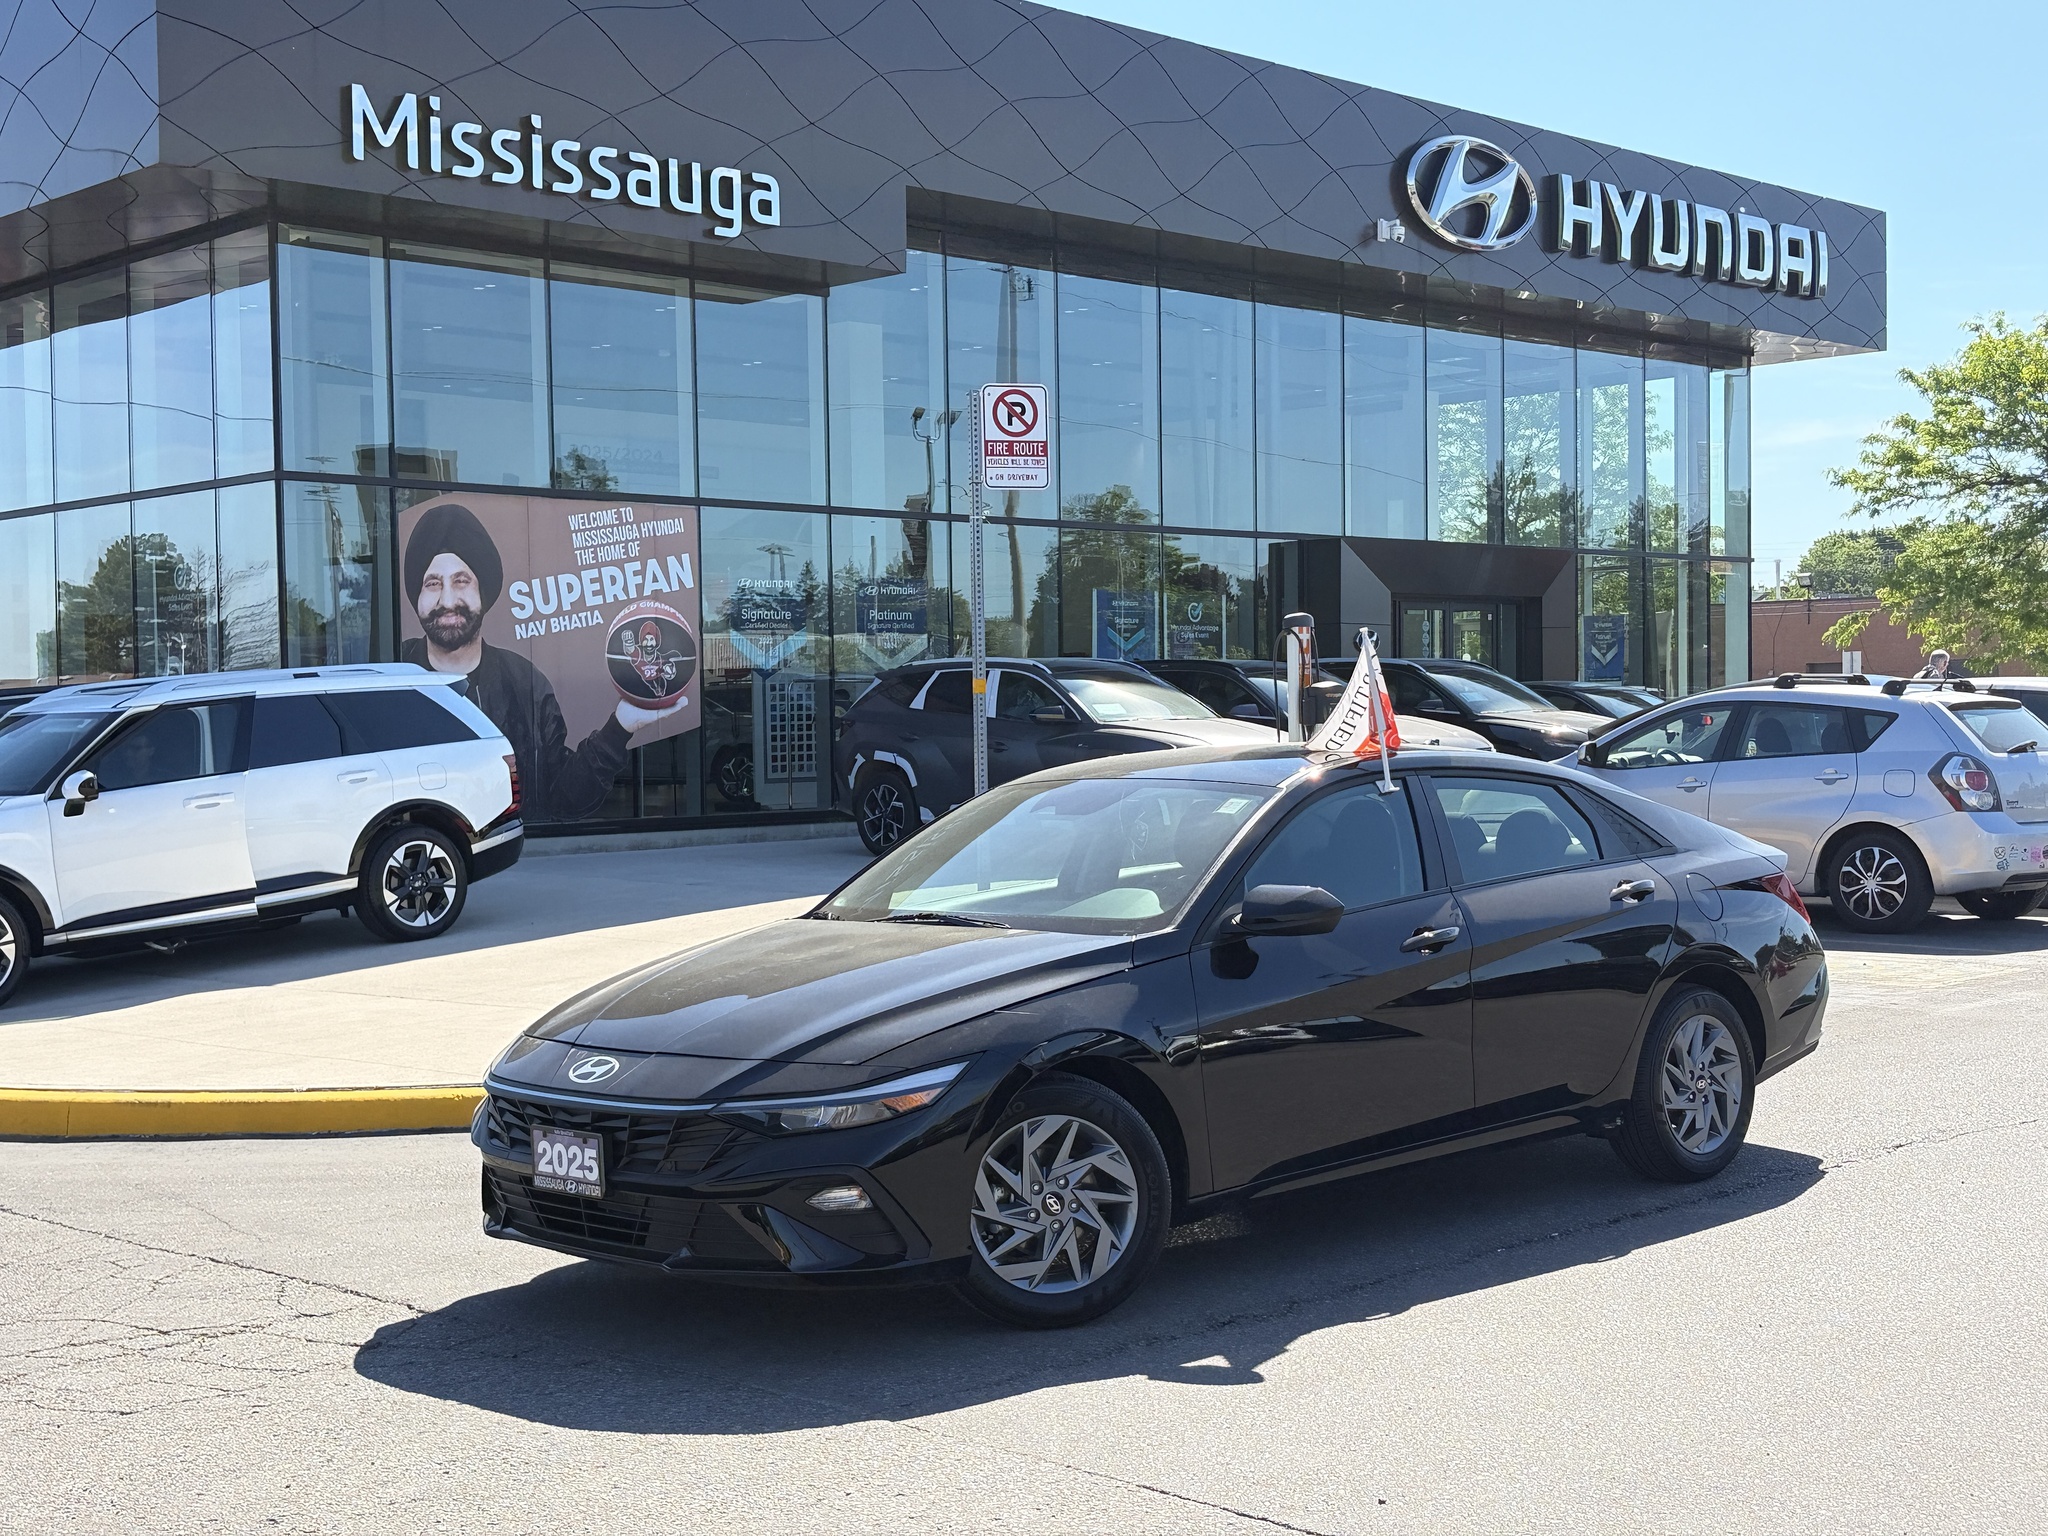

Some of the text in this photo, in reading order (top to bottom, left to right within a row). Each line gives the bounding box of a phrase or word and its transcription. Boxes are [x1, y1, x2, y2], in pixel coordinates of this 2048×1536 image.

[350, 82, 781, 238] Mississauga
[1556, 173, 1829, 298] HYUNDAI
[987, 442, 1045, 456] FIRE ROUTE
[987, 458, 1009, 466] VEHICLES
[1011, 458, 1022, 466] WILL
[995, 473, 1039, 481] ON DRIVEWAY
[568, 506, 634, 531] WELCOME TO
[572, 517, 685, 549] MISSISSAUGA HYUNDAI
[574, 541, 641, 566] THE HOME OF
[508, 552, 695, 620] SUPERFAN
[754, 579, 793, 588] HYUNDAI
[880, 586, 916, 595] HYUNDAI
[514, 609, 604, 640] NAV BHATIA
[741, 607, 792, 622] Signature
[744, 621, 769, 629] Certified
[869, 609, 912, 621] Platinum
[537, 1140, 599, 1181] 2025
[534, 1175, 601, 1197] MISSISSAUGA HYUNDAI
